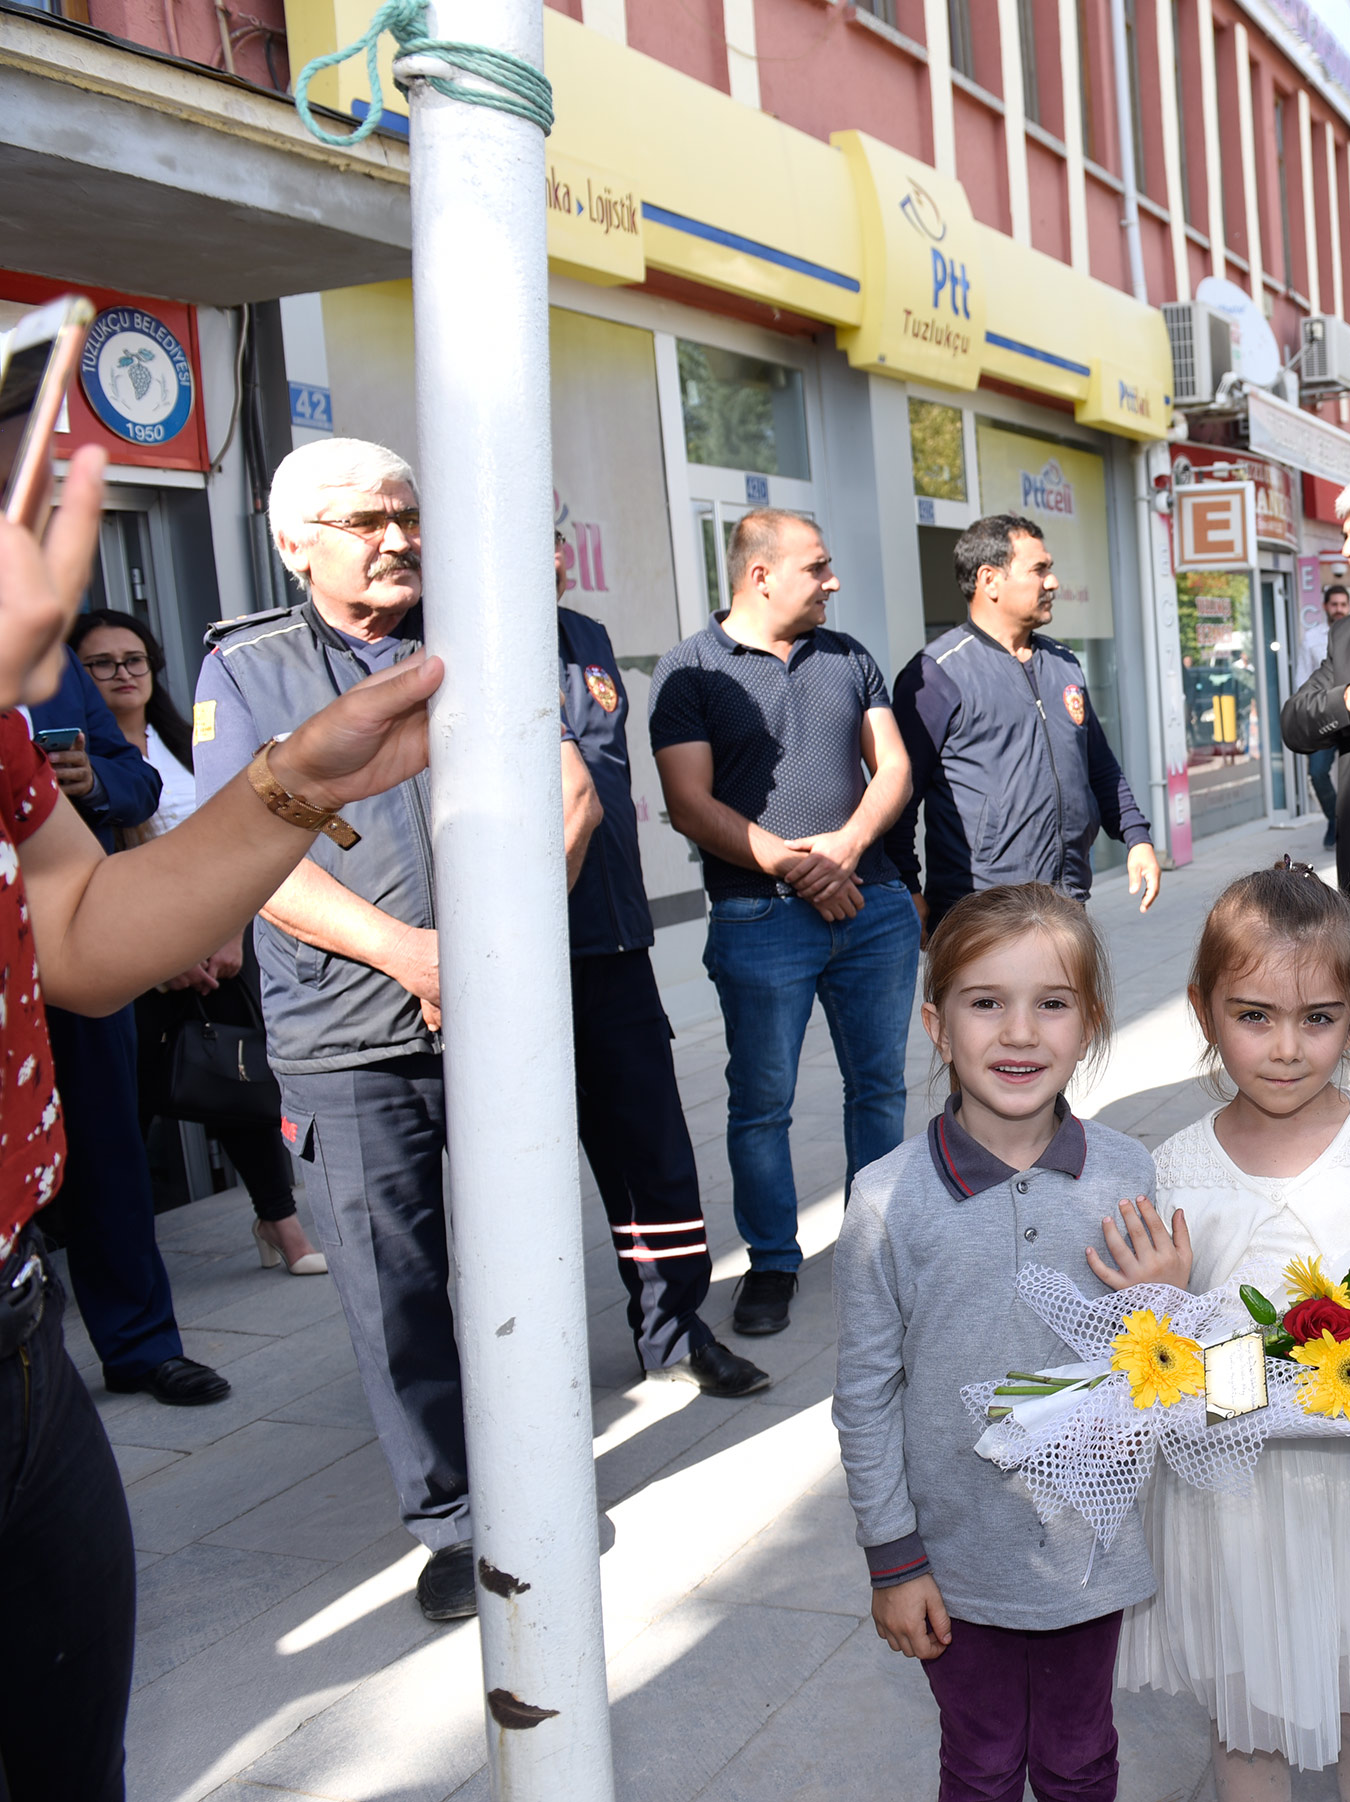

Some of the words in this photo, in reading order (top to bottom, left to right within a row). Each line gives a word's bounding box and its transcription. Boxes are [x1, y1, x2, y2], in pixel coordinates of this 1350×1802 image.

[586, 178, 639, 235] Lojistik
[930, 246, 970, 320] Ptt
[82, 311, 131, 373] TUZLUKÇU
[903, 307, 971, 357] Tuzlukçu
[296, 389, 327, 420] 42
[126, 423, 164, 441] 1950
[1192, 501, 1235, 554] E
